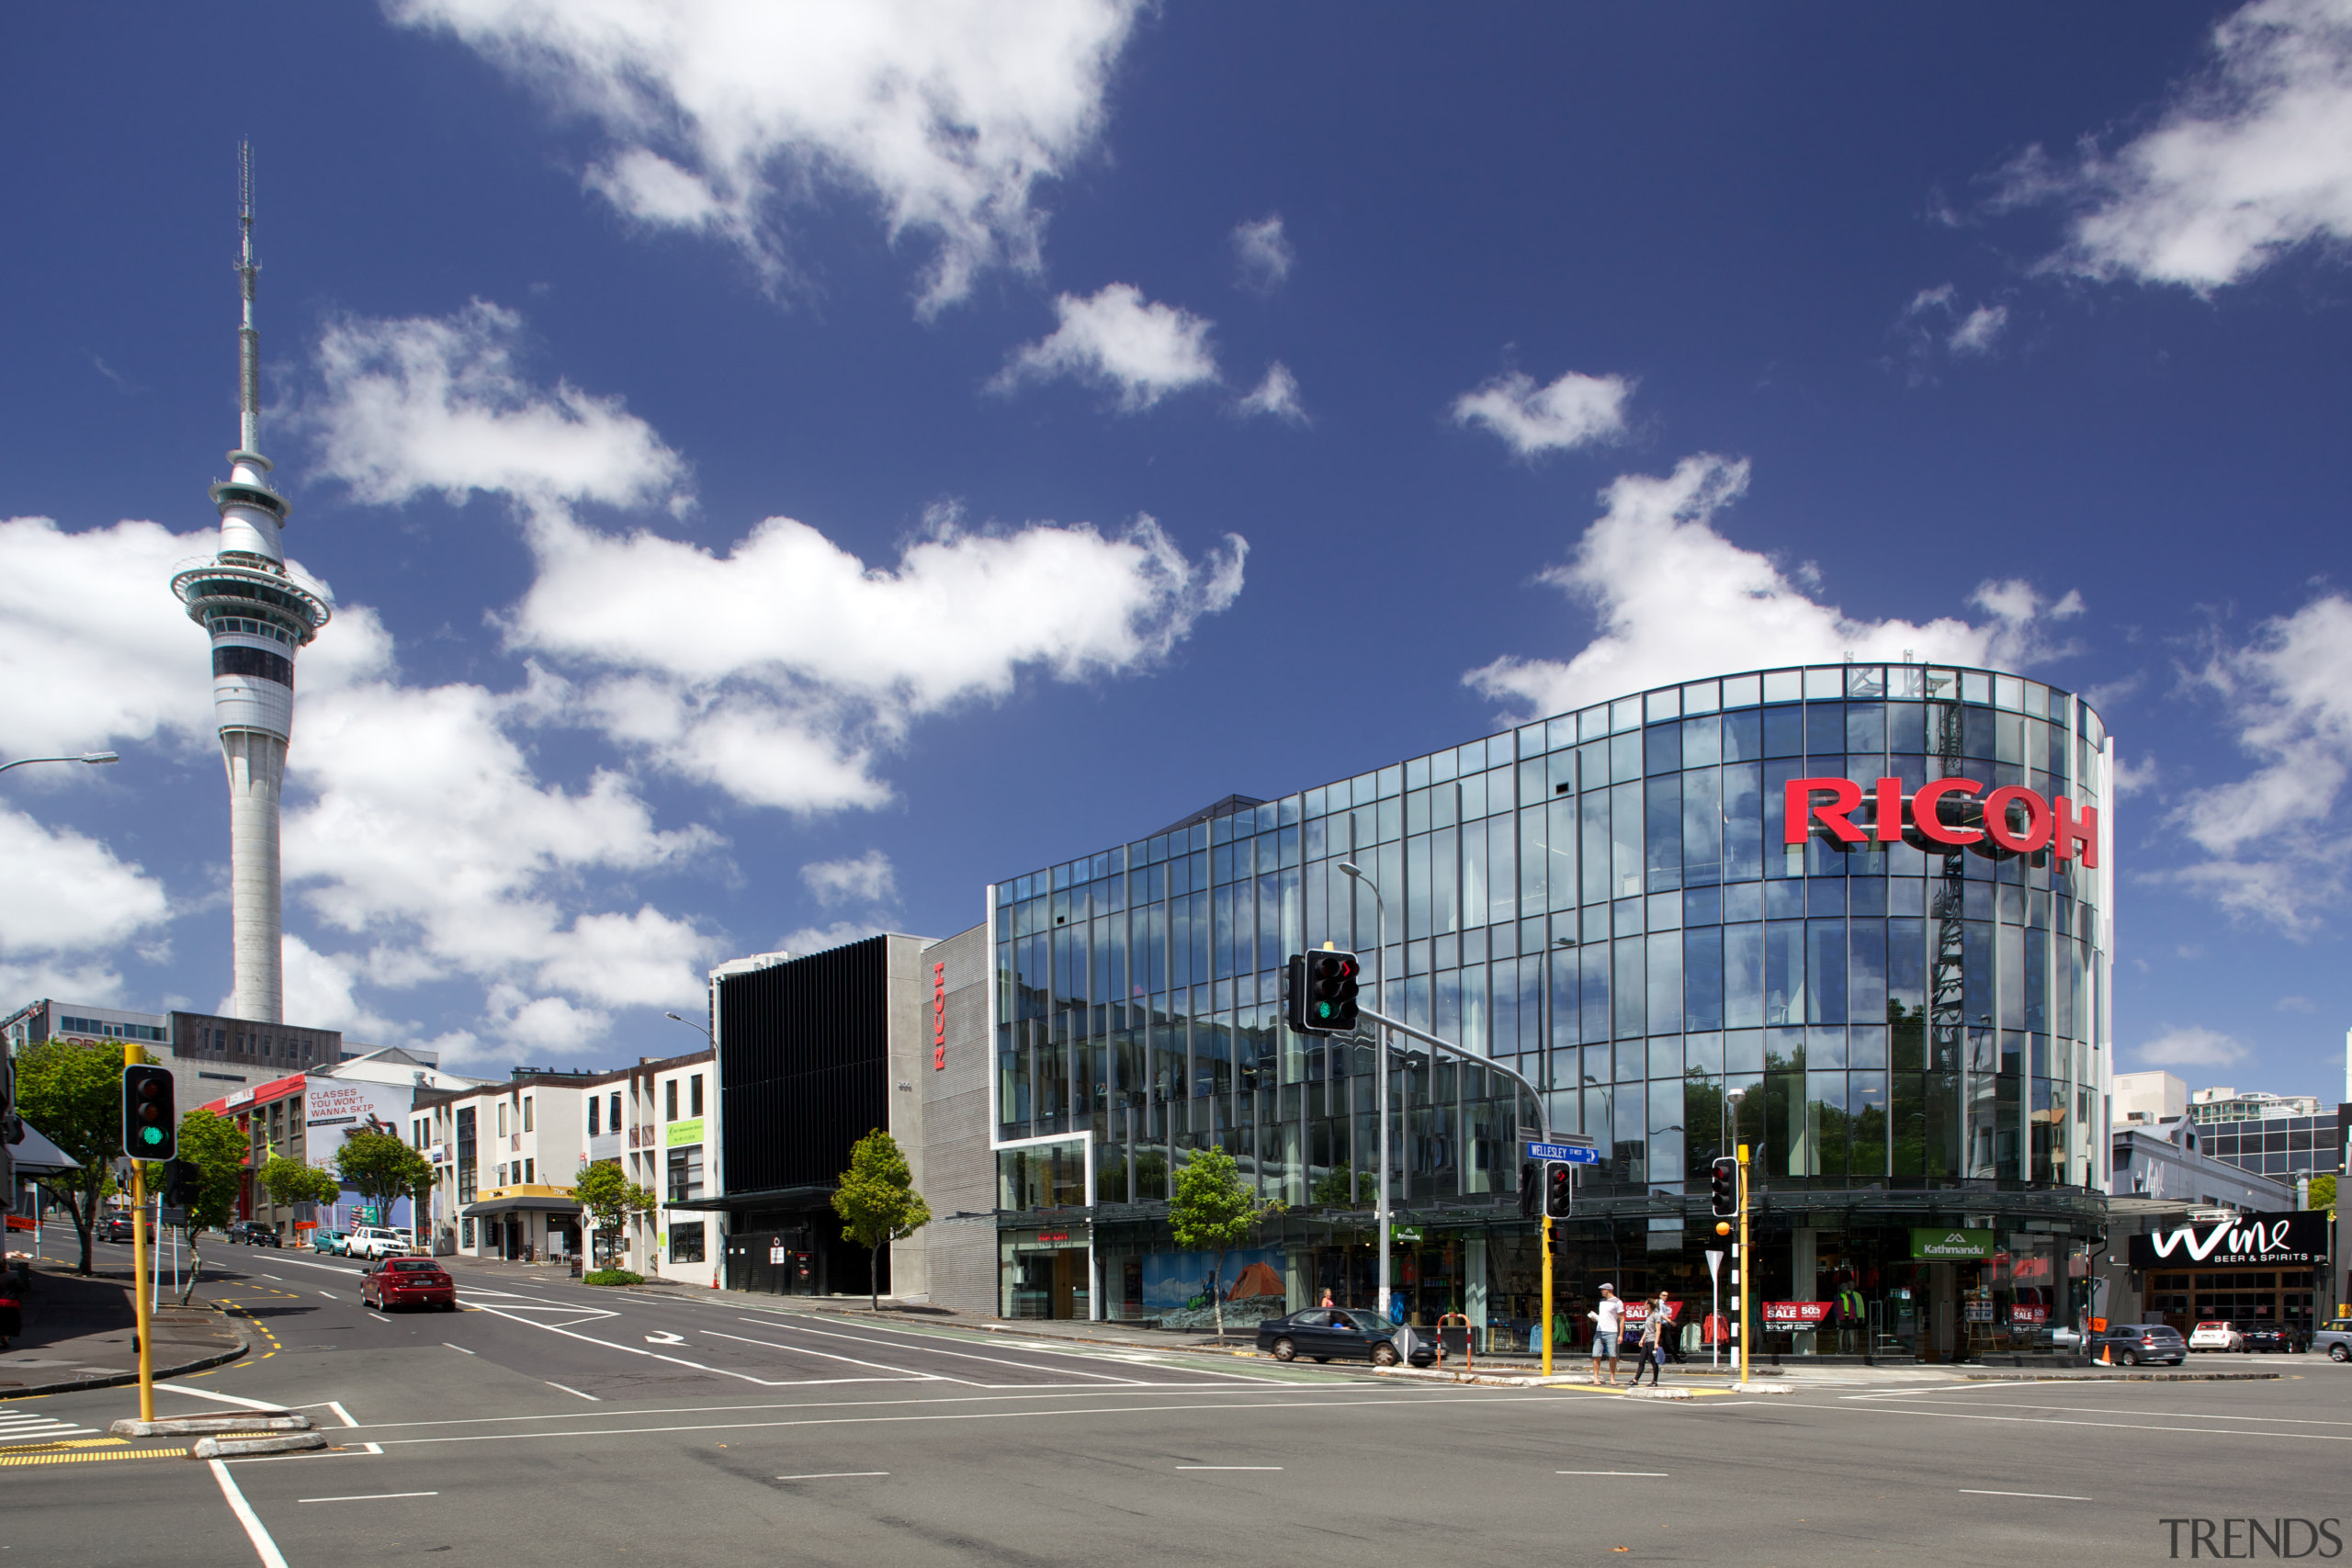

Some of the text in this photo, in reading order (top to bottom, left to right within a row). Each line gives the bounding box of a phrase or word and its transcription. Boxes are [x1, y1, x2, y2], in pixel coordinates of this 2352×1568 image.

[1784, 777, 2098, 869] RICOH
[933, 962, 945, 1070] RICOH
[311, 1089, 357, 1100] CLASSES
[311, 1096, 364, 1109] YOU WON'T
[311, 1103, 374, 1117] WANNA SKIP
[1532, 1145, 1566, 1158] WELLESLEY
[553, 1188, 566, 1196] The
[1924, 1244, 1984, 1255] Kathmandu
[2214, 1253, 2309, 1263] BEER & SPIRITS
[1767, 1310, 1797, 1318] SALE
[1801, 1306, 1820, 1314] 50%
[2013, 1312, 2032, 1320] SALE
